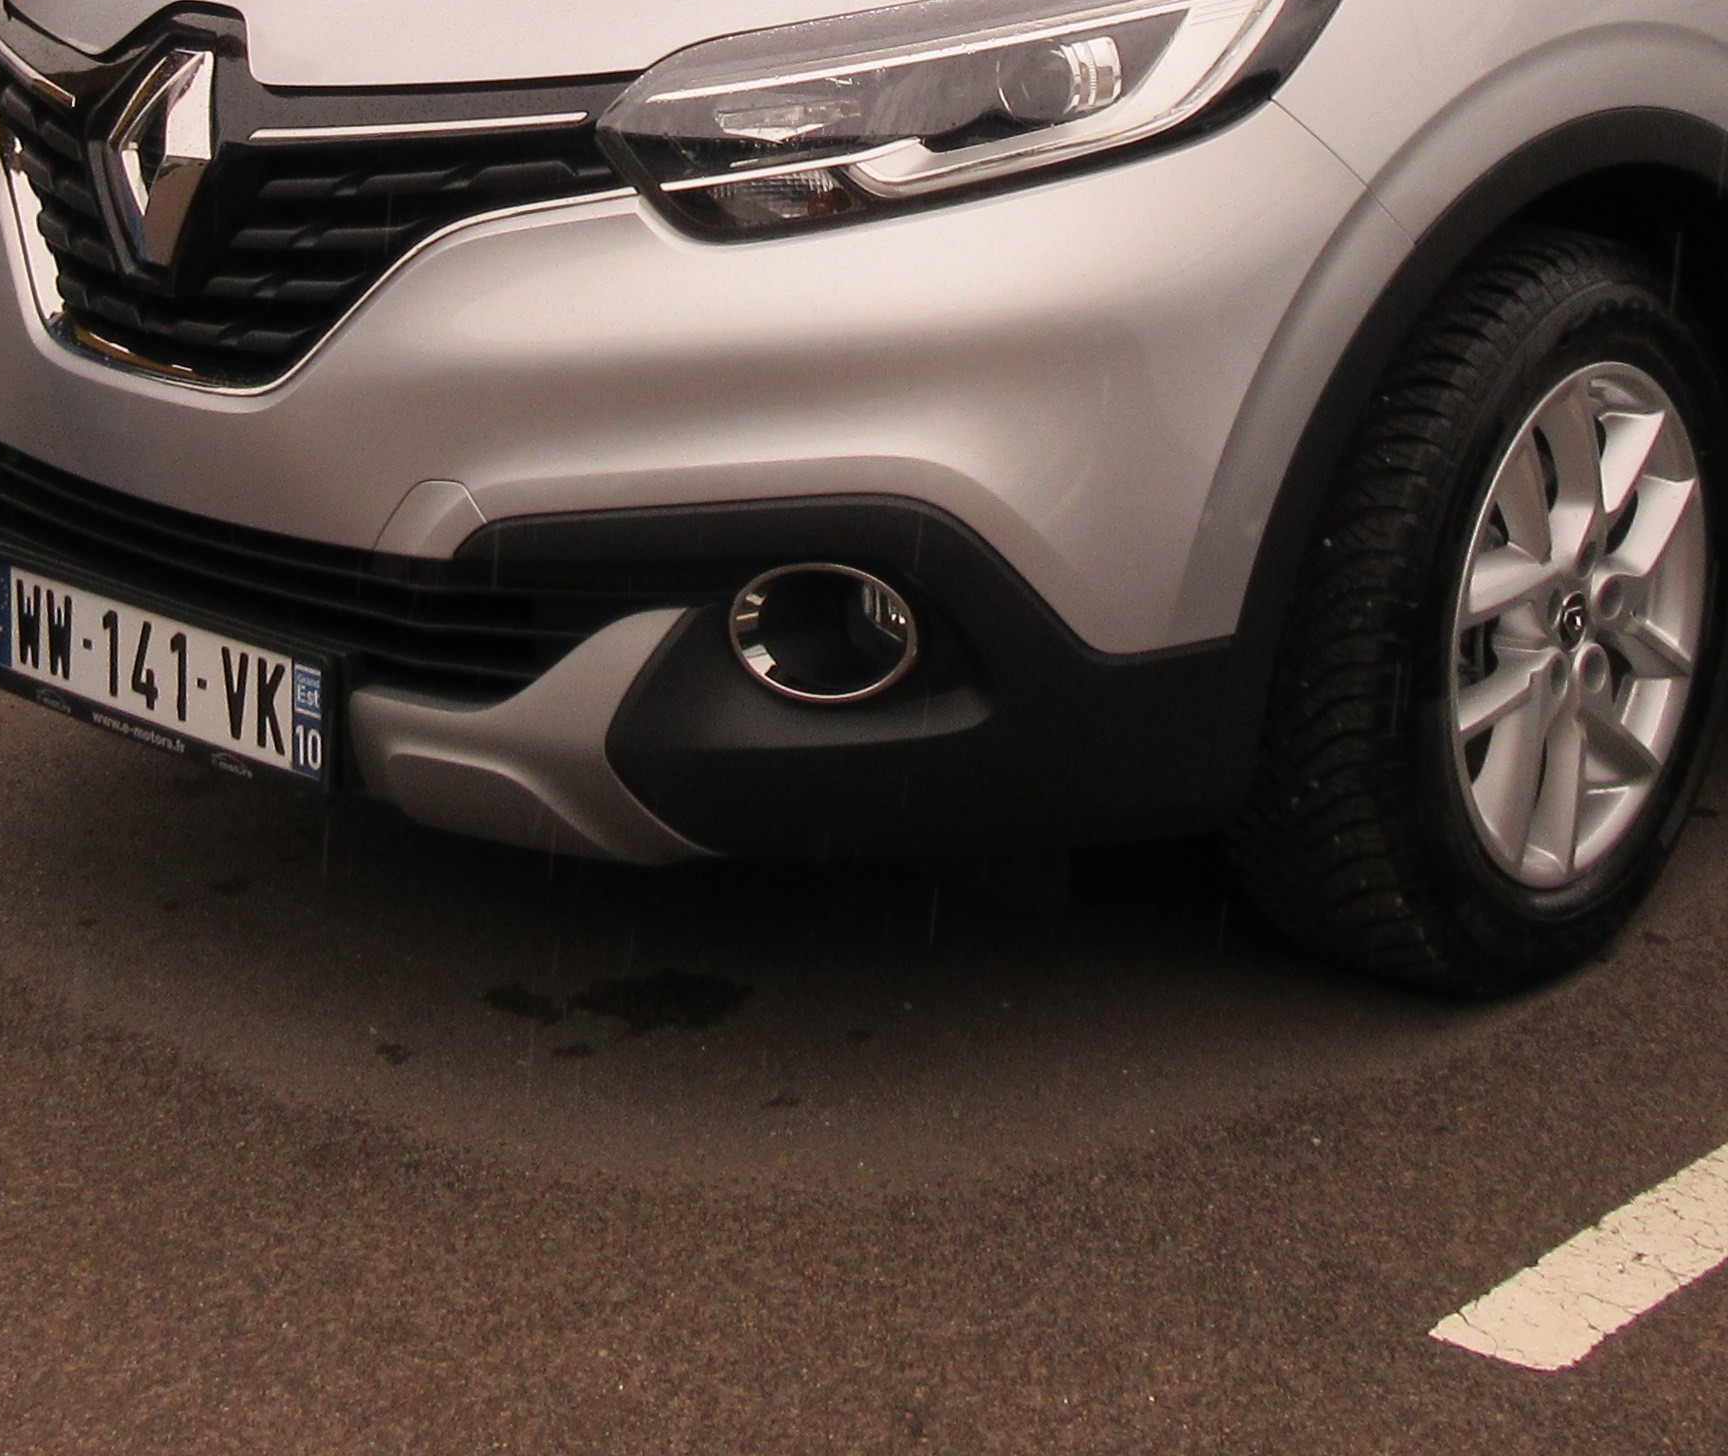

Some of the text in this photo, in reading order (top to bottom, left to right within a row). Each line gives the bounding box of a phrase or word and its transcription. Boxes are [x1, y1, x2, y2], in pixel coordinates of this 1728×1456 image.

[16, 578, 286, 756] WW-141-VK
[296, 684, 321, 708] Est
[295, 724, 322, 771] 10
